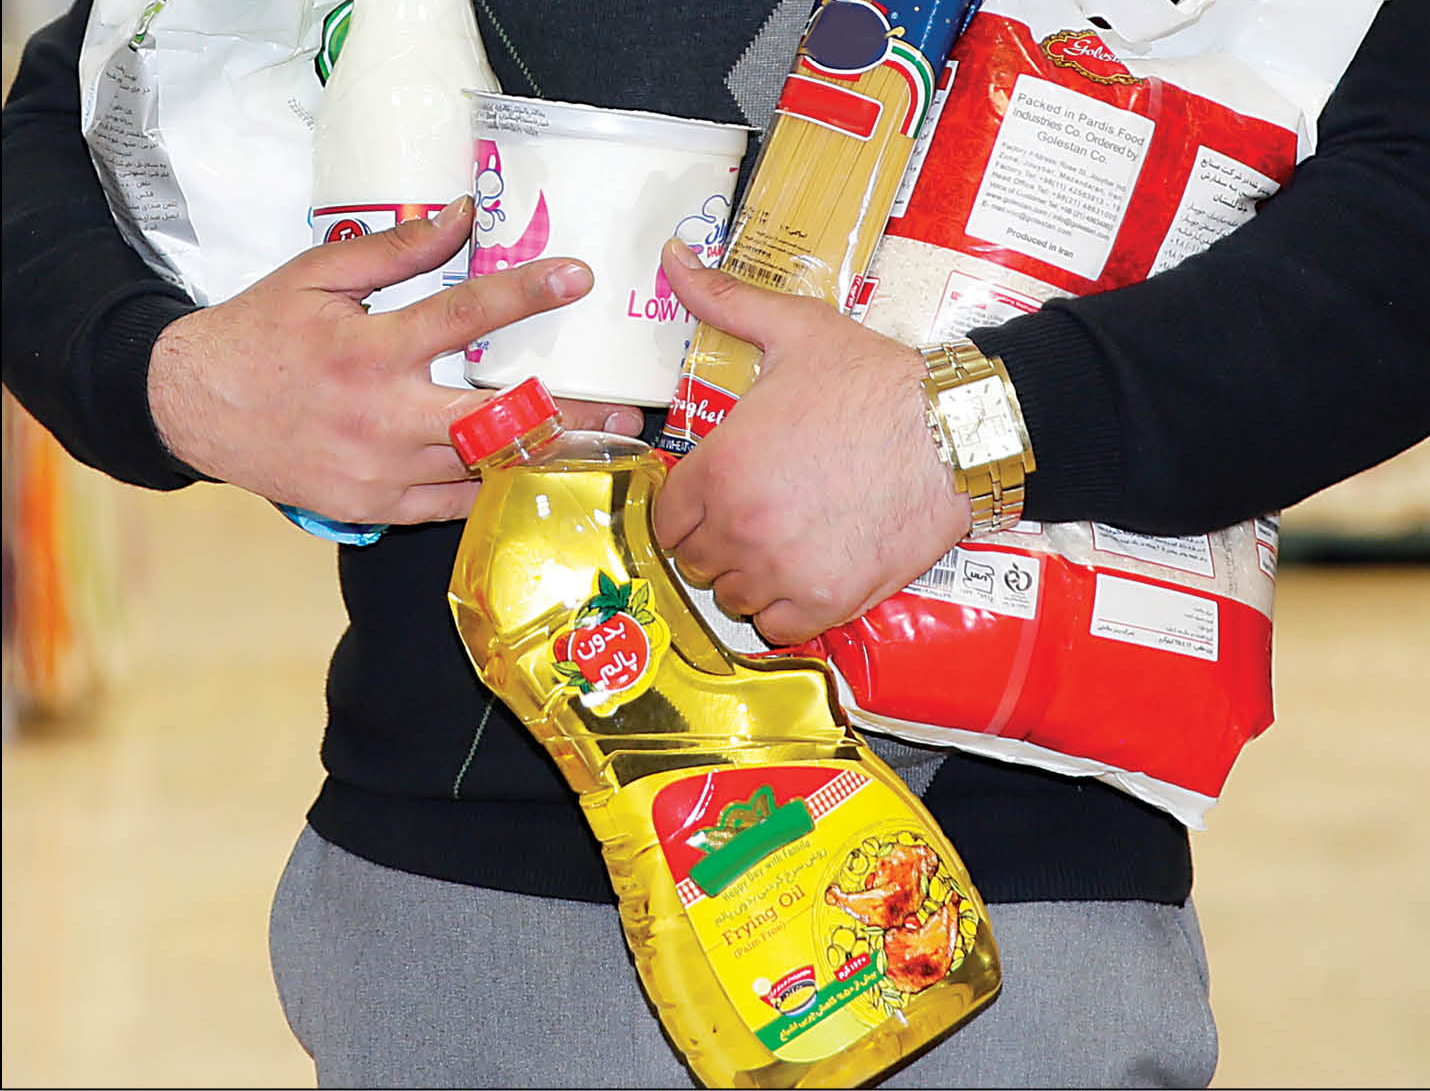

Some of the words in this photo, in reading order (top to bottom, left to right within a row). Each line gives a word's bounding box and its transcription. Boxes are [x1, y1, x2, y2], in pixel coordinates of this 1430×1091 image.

[1013, 109, 1062, 131] Industries
[1065, 125, 1081, 138] Co.
[1085, 133, 1126, 155] Ordered
[1127, 149, 1138, 161] by
[1017, 93, 1062, 115] Packed
[1064, 110, 1074, 119] in
[1078, 114, 1114, 134] Pardis
[1118, 128, 1145, 146] Food
[1037, 131, 1088, 156] Golestan
[1090, 150, 1108, 164] Co.
[1007, 227, 1048, 248] Produced
[1049, 242, 1056, 251] in
[1059, 245, 1074, 258] Iran
[670, 389, 725, 425] paghet
[577, 622, 625, 660] بدون
[600, 651, 638, 685] پالم
[723, 883, 747, 901] Happy
[748, 870, 764, 882] Day
[766, 857, 783, 869] with
[722, 907, 778, 945] Frying
[778, 885, 806, 908] Oil
[735, 937, 761, 958] (Palm
